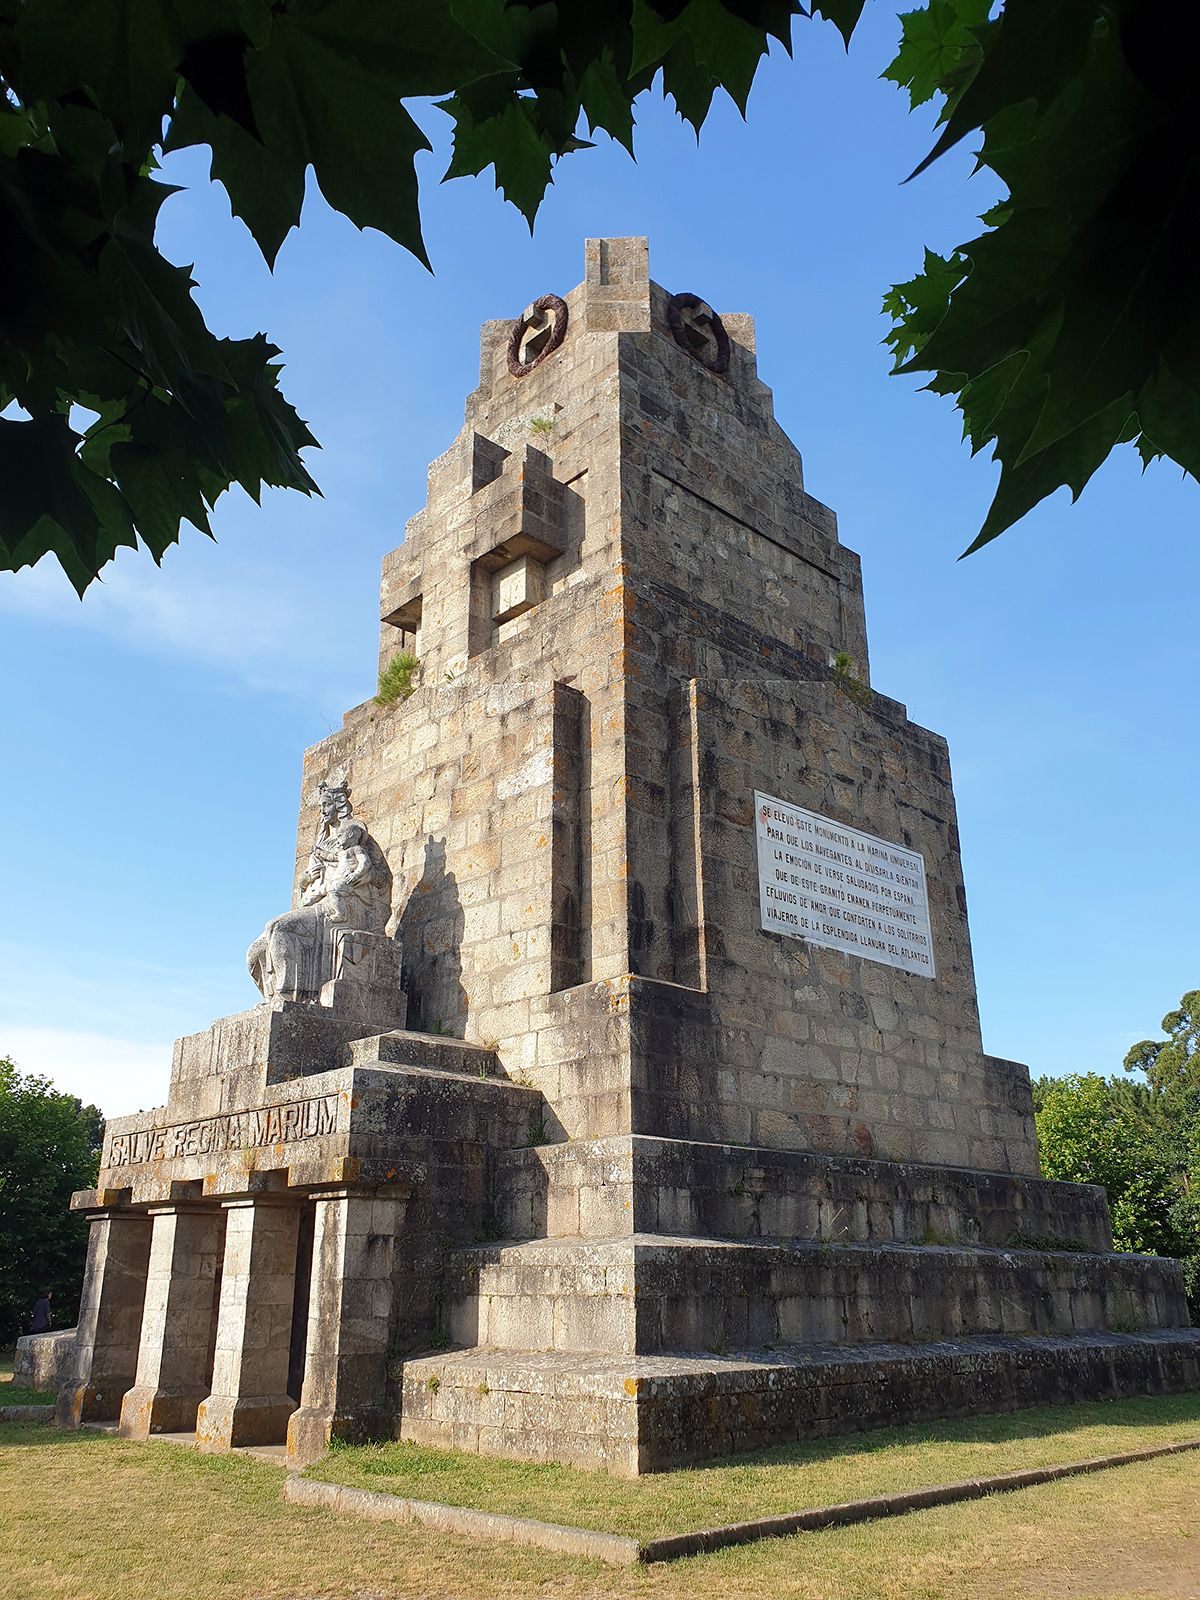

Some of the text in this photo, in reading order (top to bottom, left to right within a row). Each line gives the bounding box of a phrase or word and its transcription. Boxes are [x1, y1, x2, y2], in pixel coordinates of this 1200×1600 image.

[762, 805, 772, 818] SE
[797, 818, 812, 833] ESTE
[814, 825, 848, 847] MONUMENTO
[851, 840, 856, 849] A
[857, 842, 865, 852] LA
[867, 844, 888, 861] MARINA
[890, 854, 920, 874] UNIVERSAL
[767, 827, 784, 842] PARA
[786, 834, 798, 847] QUE
[801, 840, 814, 852] LOS
[856, 859, 862, 870] AL
[864, 862, 894, 880] DIVISARLA
[896, 874, 919, 890] SIENTAN
[774, 850, 782, 861] LA
[786, 854, 812, 872] EMOCIÓN
[814, 864, 822, 874] DE
[825, 866, 844, 882] VERSE
[846, 874, 878, 894] SALUDADOS
[880, 886, 892, 898] POR
[776, 868, 916, 924] QUE DE ESTE GRANITO EMANEN PERPETUAMENTE
[766, 886, 926, 946] EFLUVIOS DE AMOR QUE CONFORTEN A LOS SOLITARIOS
[766, 906, 798, 925] VIAJEROS
[801, 917, 808, 928] DE
[812, 920, 820, 932] LA
[860, 936, 886, 952] LLANURA
[888, 944, 898, 956] DEL
[110, 1097, 338, 1167] SALVE REGINA MARIUM
